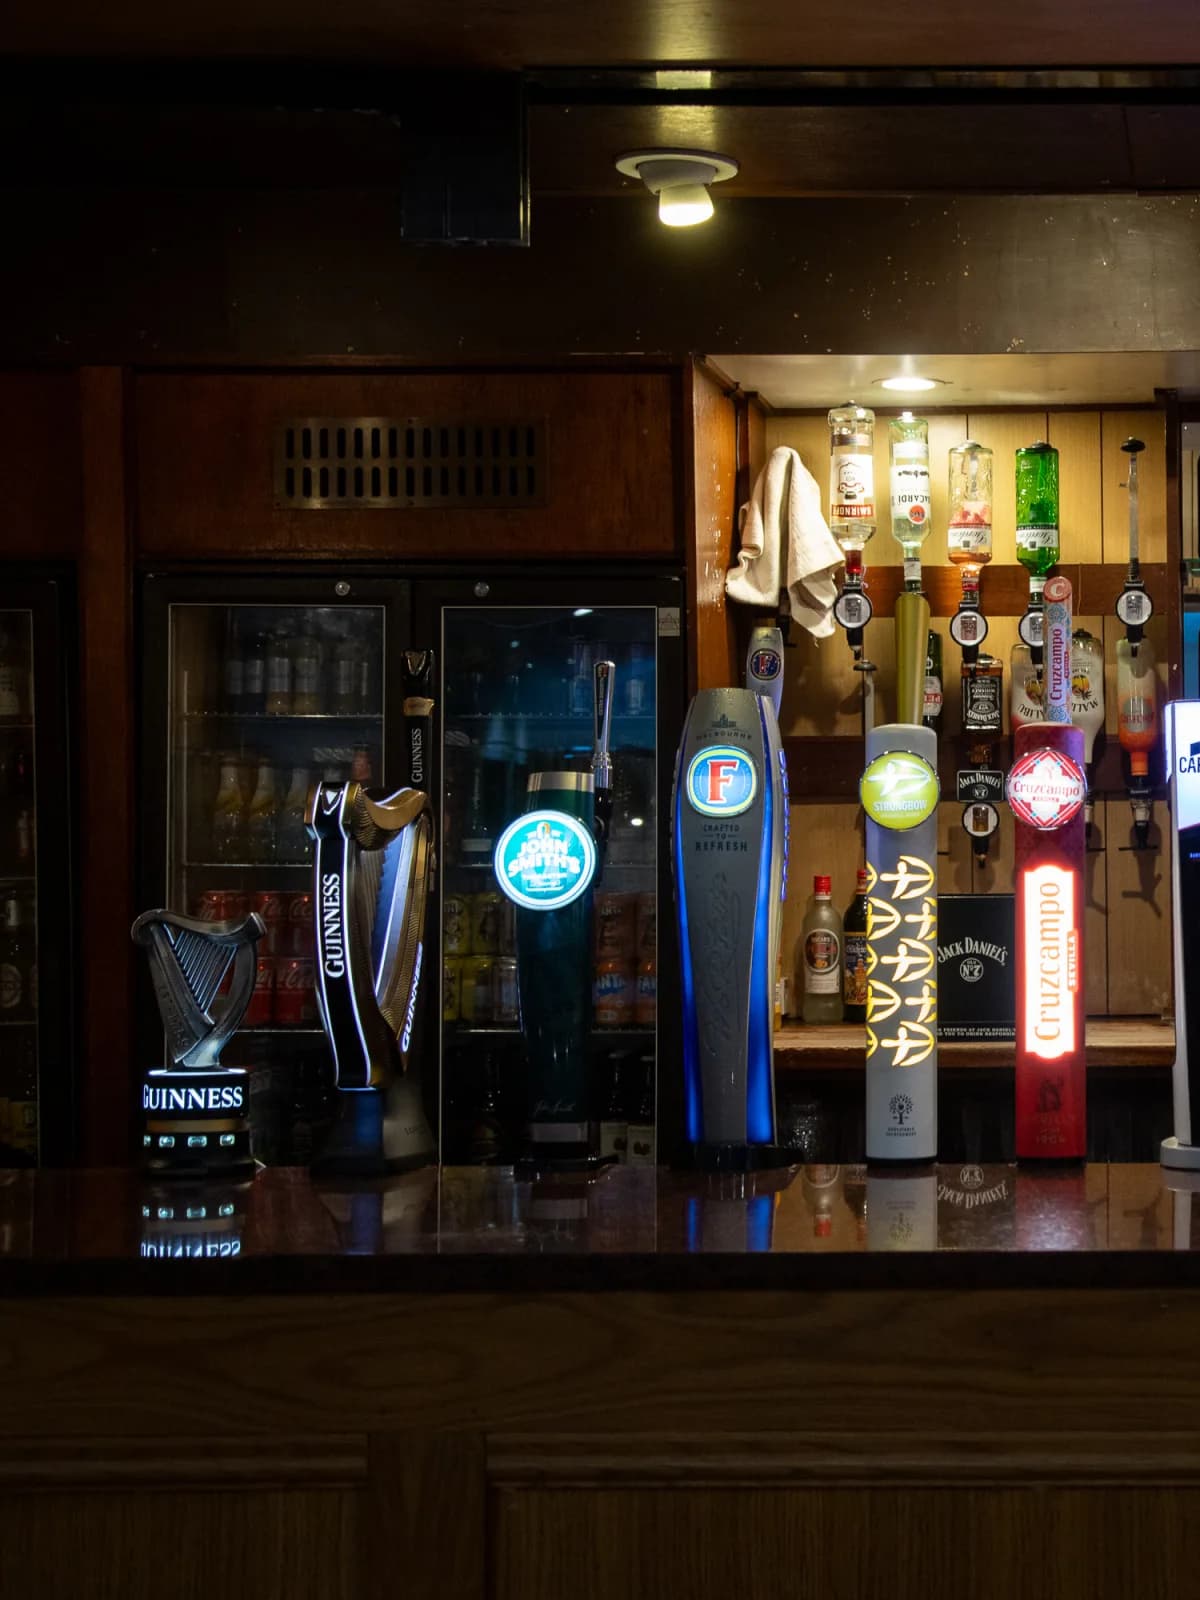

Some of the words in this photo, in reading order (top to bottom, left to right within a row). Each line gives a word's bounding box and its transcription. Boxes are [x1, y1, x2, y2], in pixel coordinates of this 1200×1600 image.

[1050, 582, 1064, 597] C
[1050, 628, 1063, 700] Cruzcampo
[411, 727, 424, 783] GUINNESS
[707, 759, 739, 804] F
[959, 776, 976, 790] JACK
[976, 771, 1001, 789] DANIEL'S
[1013, 782, 1080, 798] Cruzcampo
[872, 800, 927, 812] STRONGBOW
[703, 823, 740, 833] CRAFTED
[517, 838, 569, 857] JOHN
[695, 841, 748, 852] REFRESH
[508, 853, 581, 878] SMITH'S
[322, 872, 345, 979] GUINNESS
[937, 941, 964, 964] JACK
[965, 936, 1009, 966] DANIEL'S
[1034, 882, 1065, 1041] Cruzcampo
[1067, 935, 1077, 986] SEVILLA
[143, 1083, 244, 1110] GUINNESS
